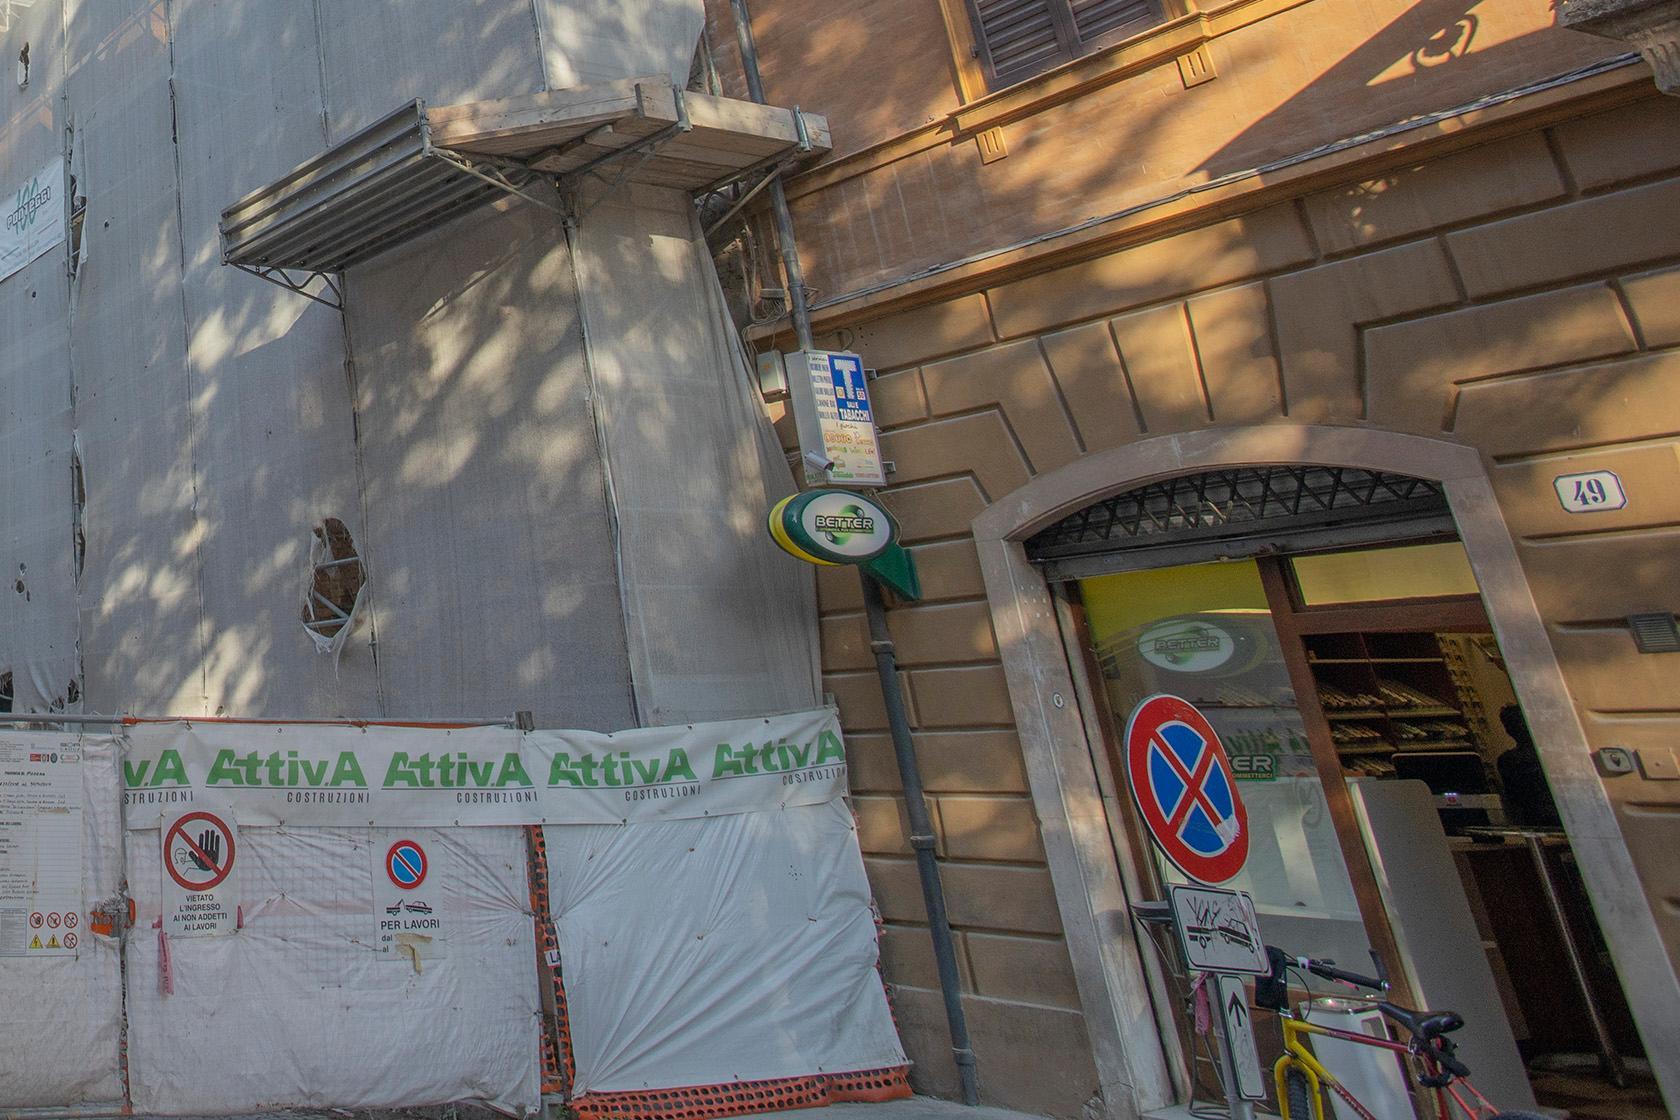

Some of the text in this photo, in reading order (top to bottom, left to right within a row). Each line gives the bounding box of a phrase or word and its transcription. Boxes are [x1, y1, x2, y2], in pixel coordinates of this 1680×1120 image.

[6, 185, 51, 231] PONTEGGI
[833, 358, 857, 399] T
[1574, 478, 1607, 506] 49
[815, 515, 874, 530] BETTER
[1155, 636, 1219, 652] BETTER
[287, 791, 370, 804] COSTRUZIONI
[456, 790, 538, 804] COSTRUZIONI
[624, 784, 701, 802] COSTRUZIONI
[185, 894, 214, 902] VIETATO
[179, 903, 221, 913] L'INGRESSO
[173, 912, 228, 922] AI NON ADDETTI
[192, 922, 218, 931] LAVORI
[380, 919, 440, 930] PER LAVORI
[381, 934, 393, 942] dal
